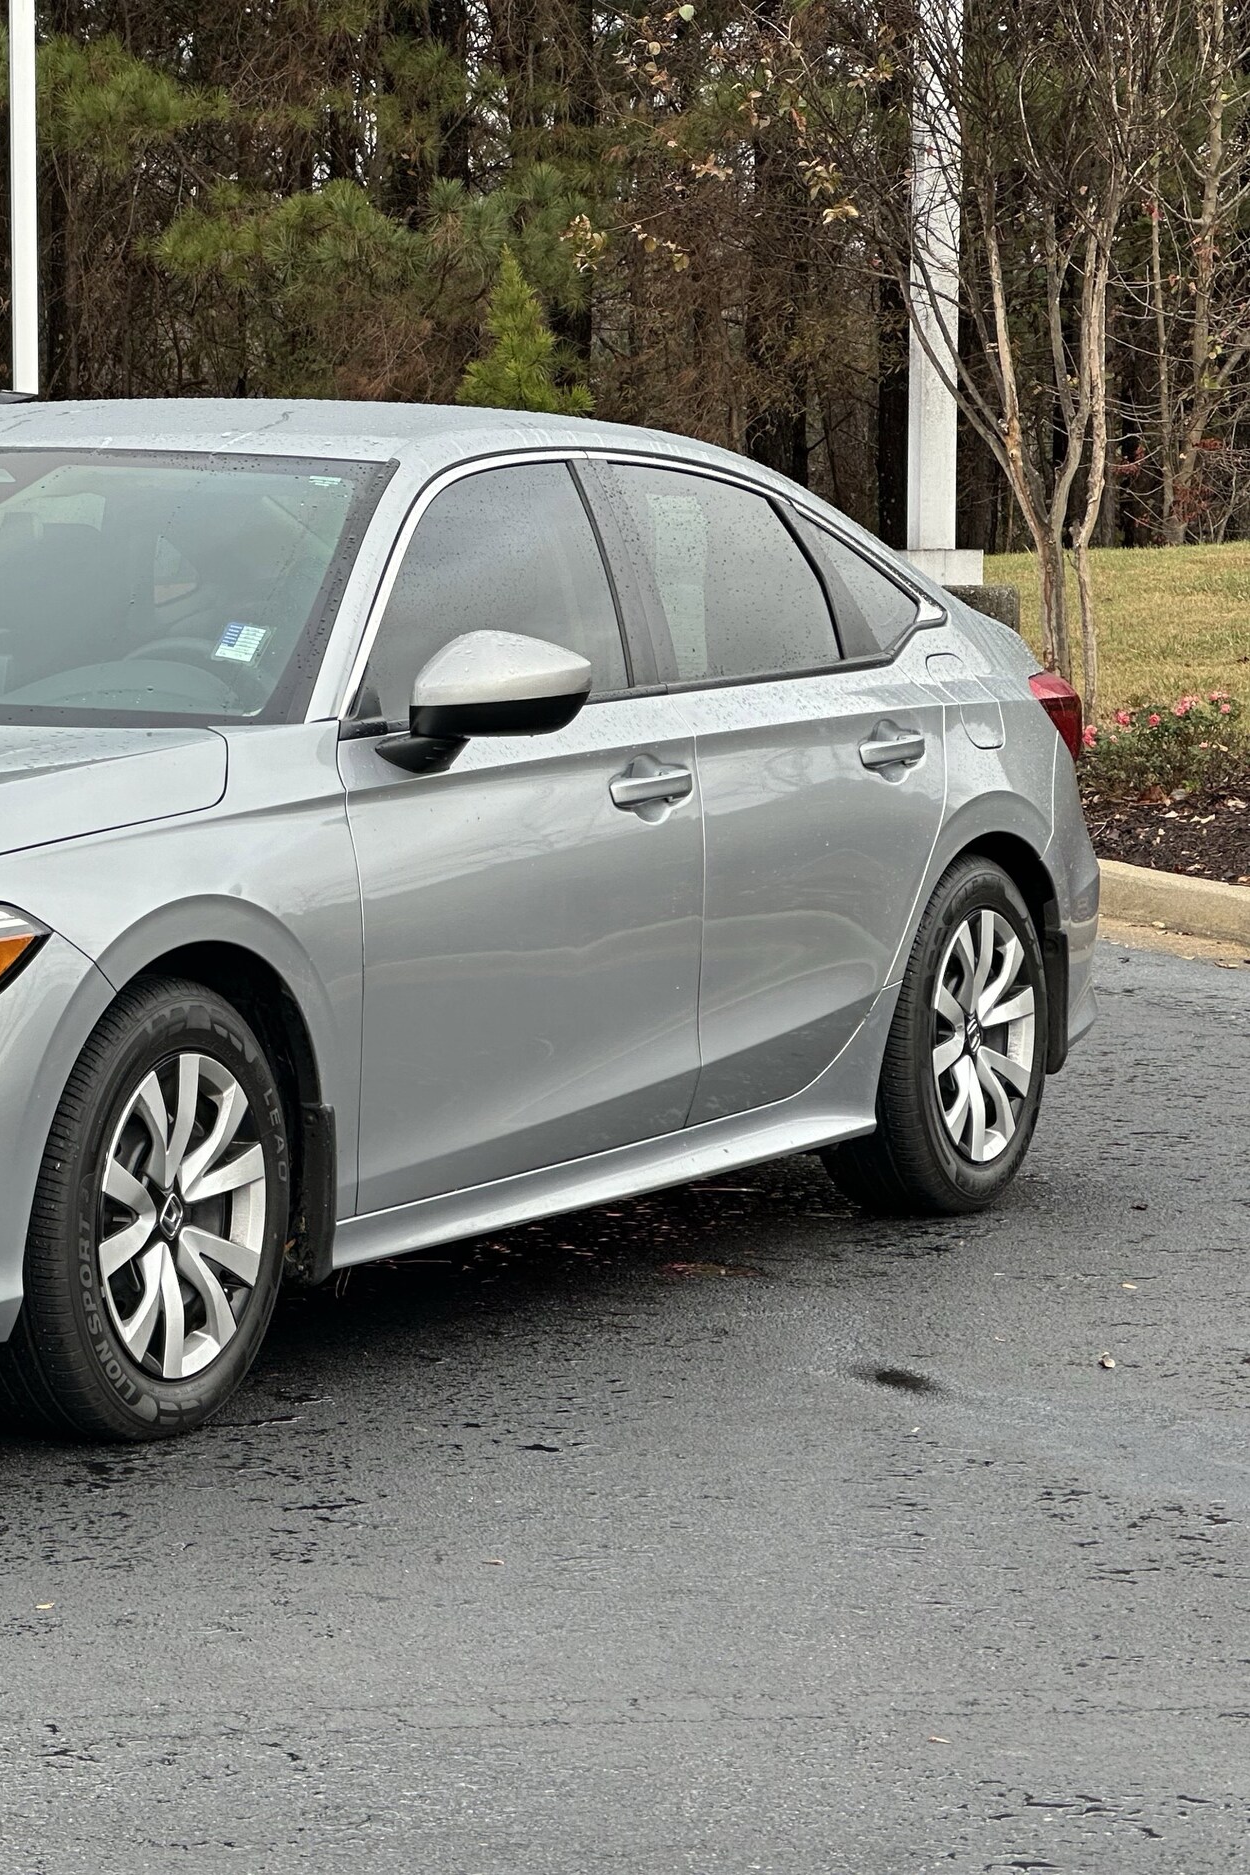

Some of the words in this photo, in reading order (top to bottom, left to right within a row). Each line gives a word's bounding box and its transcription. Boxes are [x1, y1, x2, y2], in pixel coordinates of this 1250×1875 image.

[263, 1088, 287, 1182] LEAO
[78, 1213, 103, 1336] SPORT
[95, 1340, 137, 1400] LION
